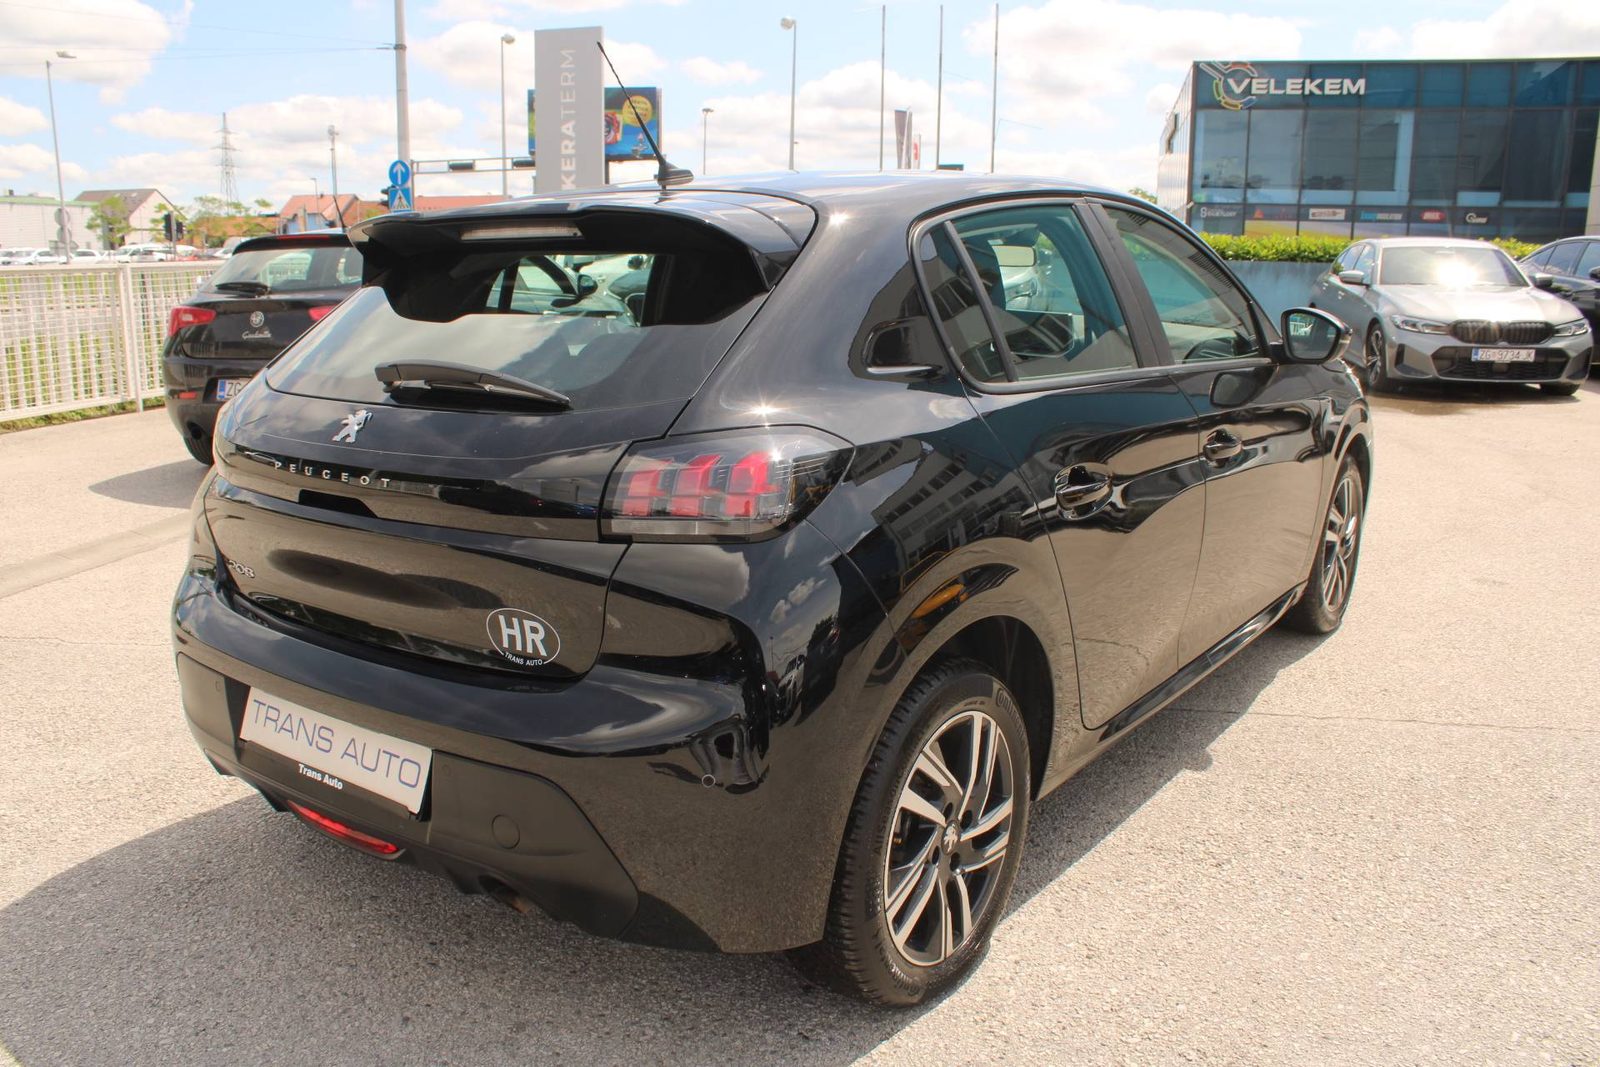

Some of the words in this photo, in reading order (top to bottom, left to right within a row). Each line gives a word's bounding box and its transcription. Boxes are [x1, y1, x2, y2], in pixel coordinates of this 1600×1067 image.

[1226, 78, 1366, 96] VELEKEM
[560, 49, 577, 190] KERATERM
[274, 461, 391, 488] PEUGEOT
[498, 614, 548, 657] HR
[504, 652, 525, 665] TRANS
[253, 699, 335, 754] TRANS
[340, 737, 422, 789] AUTO
[298, 763, 323, 782] Trans
[323, 773, 344, 790] Auto
